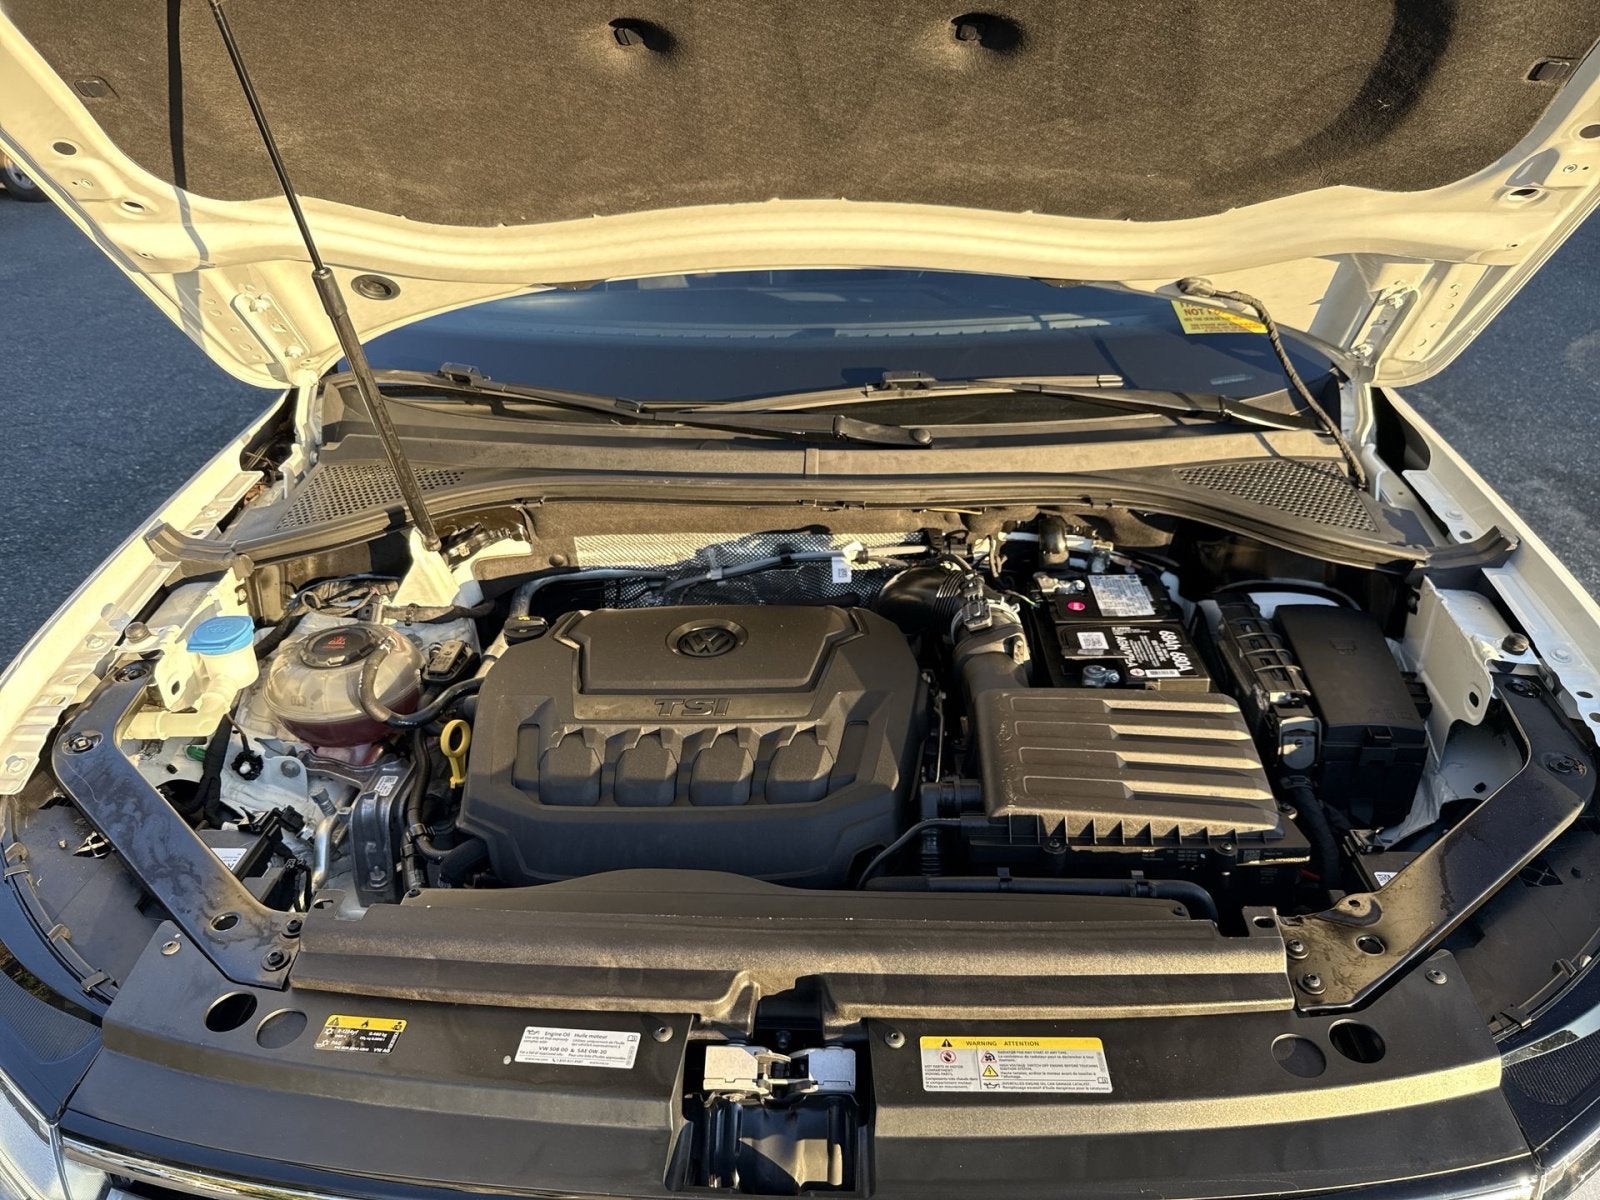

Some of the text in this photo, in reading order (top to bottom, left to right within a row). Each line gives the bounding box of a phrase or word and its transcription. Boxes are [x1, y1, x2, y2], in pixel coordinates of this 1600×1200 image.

[1184, 308, 1203, 316] NOT
[1170, 651, 1194, 672] 680A
[654, 698, 732, 717] TSI
